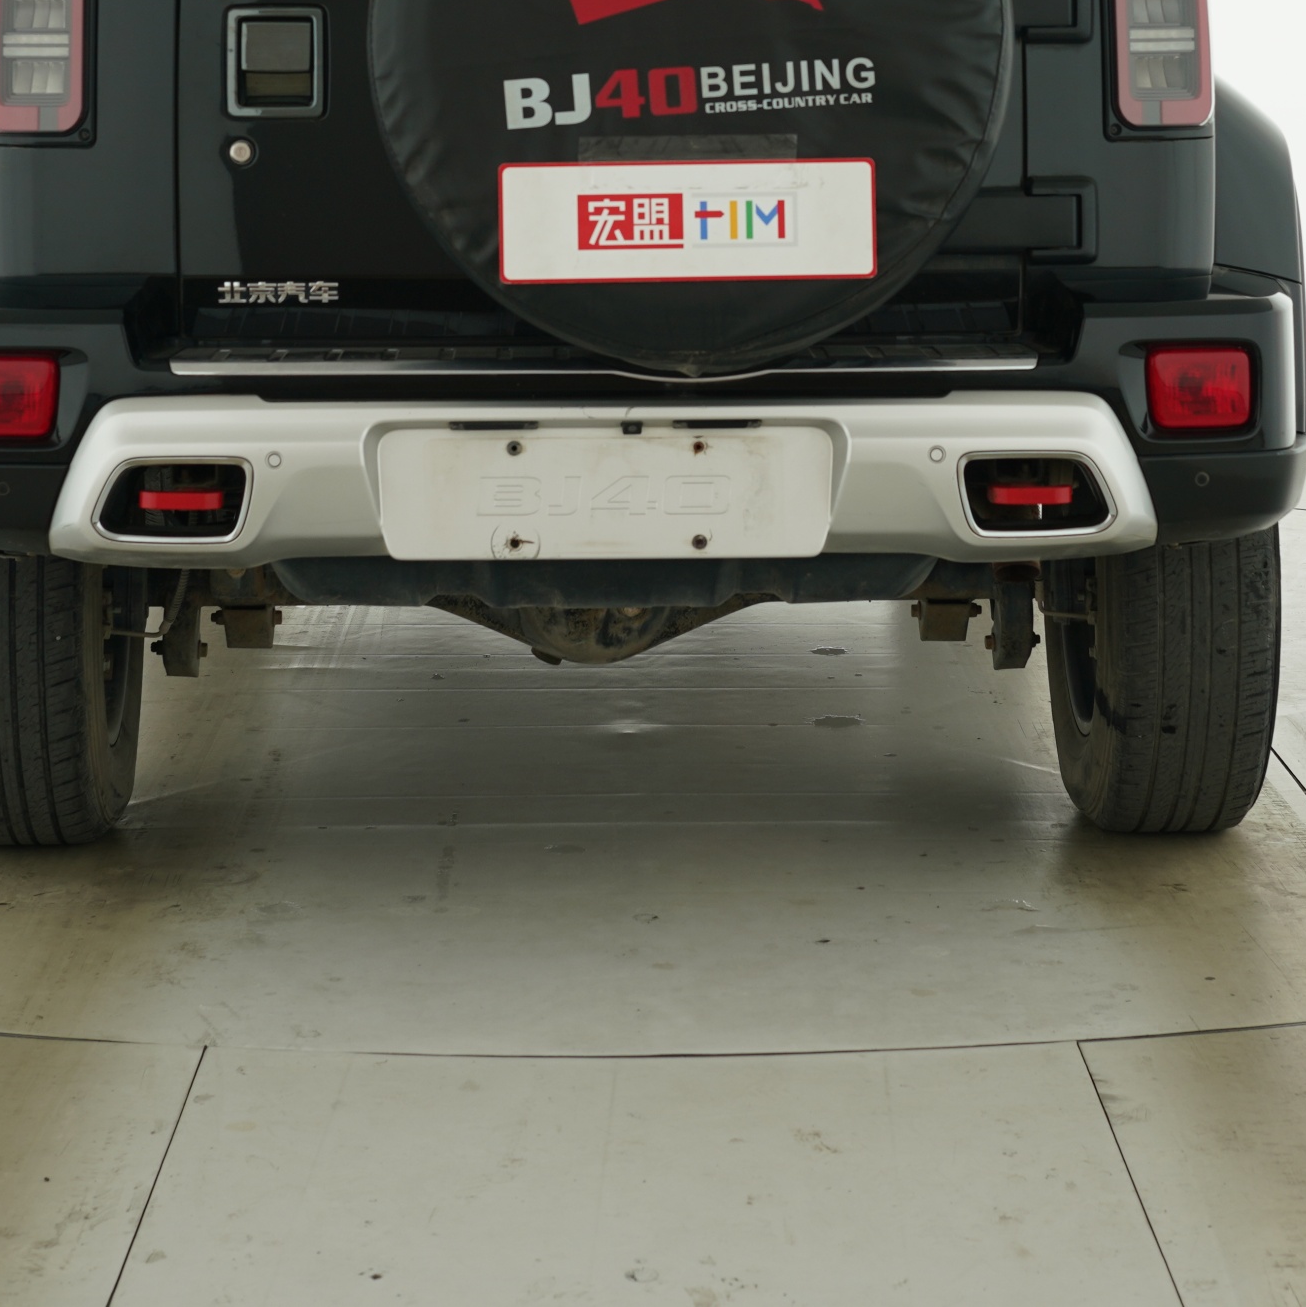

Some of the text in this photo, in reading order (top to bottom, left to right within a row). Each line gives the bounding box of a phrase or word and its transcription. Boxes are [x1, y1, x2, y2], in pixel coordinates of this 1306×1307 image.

[502, 56, 876, 131] BJ40 BEIJING
[704, 92, 874, 115] CROSS-COUNTRY CAR
[587, 196, 671, 247] 宏盟
[216, 280, 340, 304] 北京汽车
[475, 474, 732, 517] BJ40
